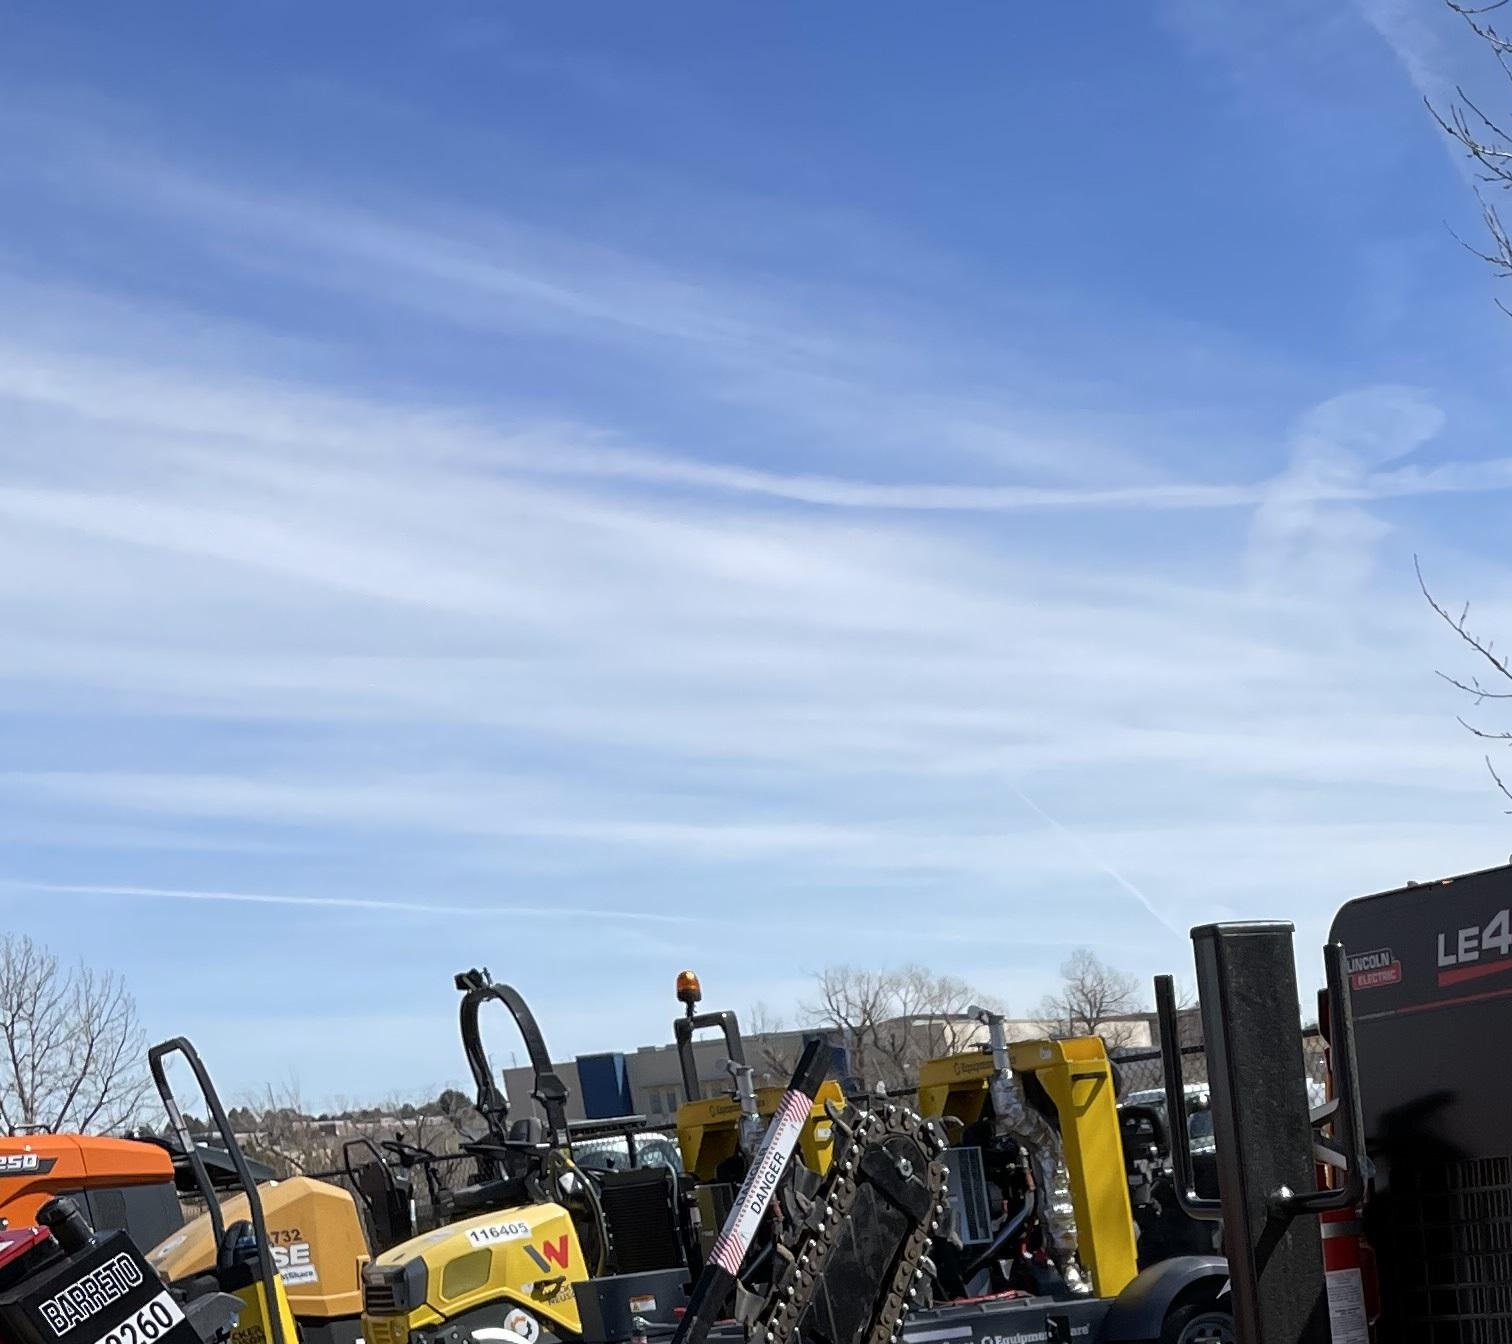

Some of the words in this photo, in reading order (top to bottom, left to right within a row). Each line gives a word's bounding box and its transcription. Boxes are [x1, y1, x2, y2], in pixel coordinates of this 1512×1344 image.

[1345, 952, 1390, 974] LINCOLN
[1357, 969, 1398, 986] ELECTRIC
[750, 1151, 786, 1216] DANGER
[469, 1222, 529, 1242] 116405
[39, 1251, 144, 1338] BARRETO
